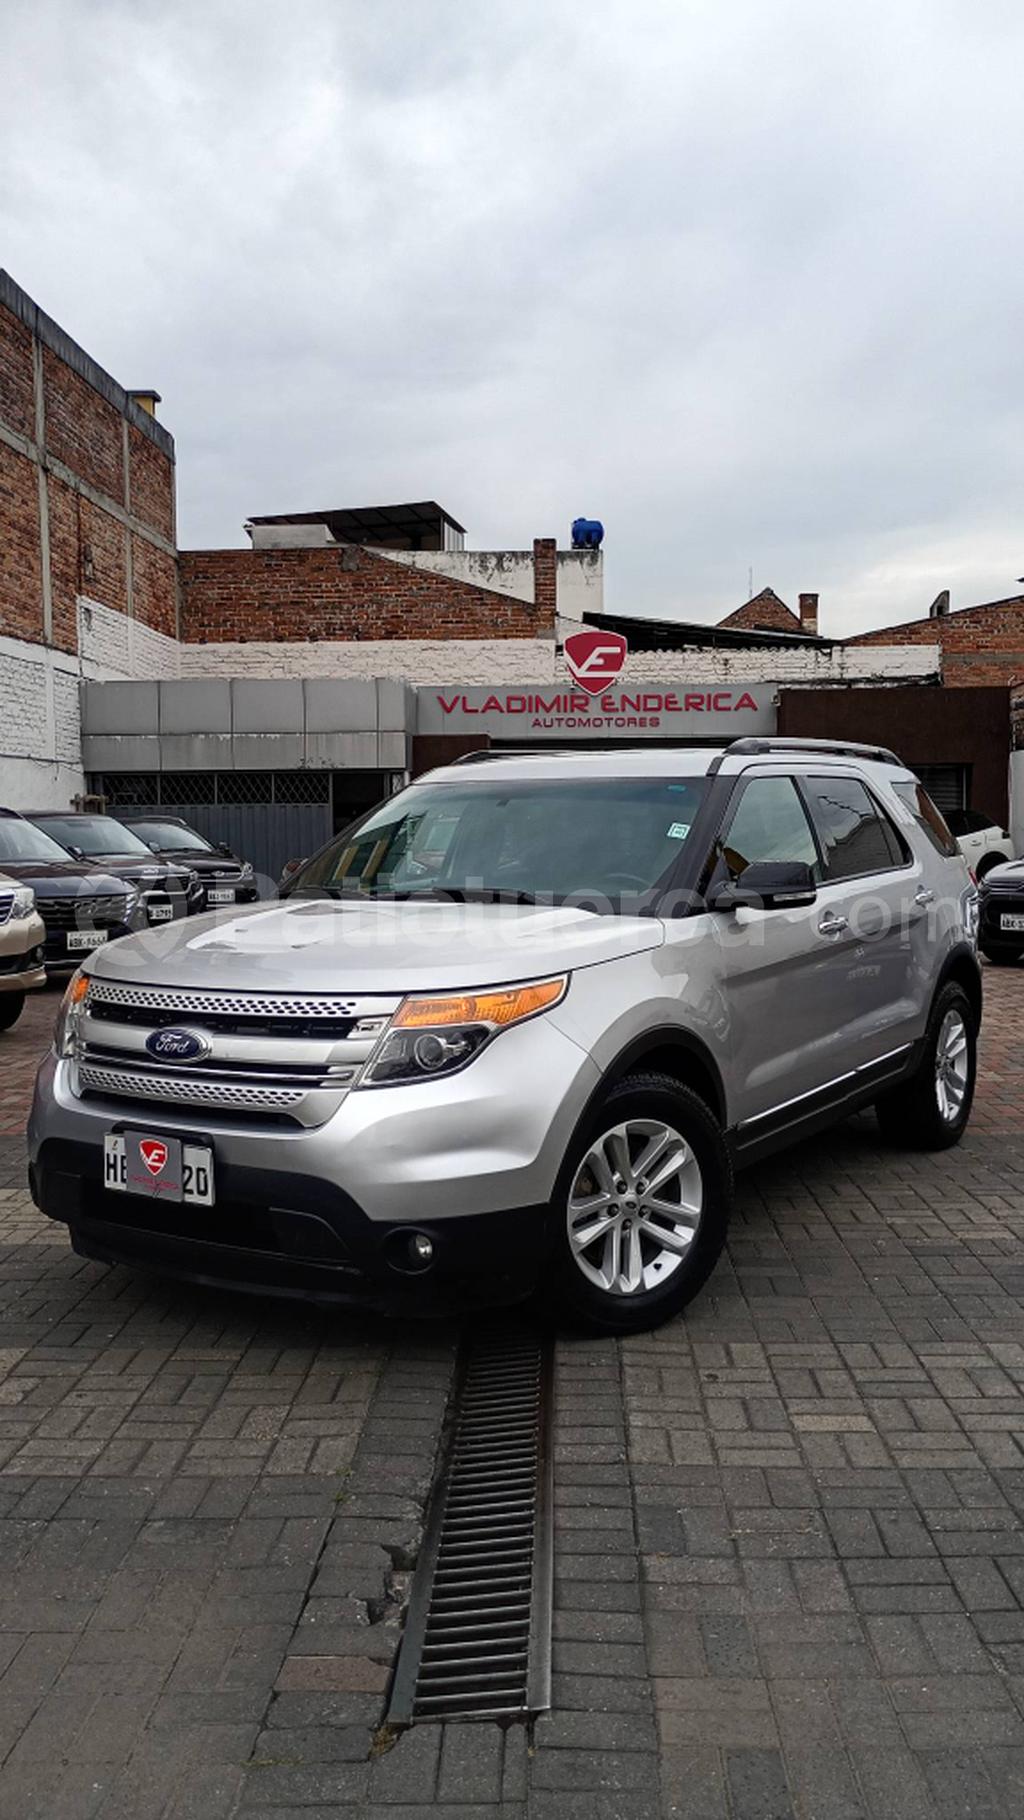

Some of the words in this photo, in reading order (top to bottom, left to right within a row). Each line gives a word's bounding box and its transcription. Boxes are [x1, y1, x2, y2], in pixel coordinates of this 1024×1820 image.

[437, 694, 590, 714] VLADIMIR
[601, 692, 758, 713] ENDERICA
[531, 717, 661, 728] AUTOMOTORES
[155, 1033, 190, 1052] Ford
